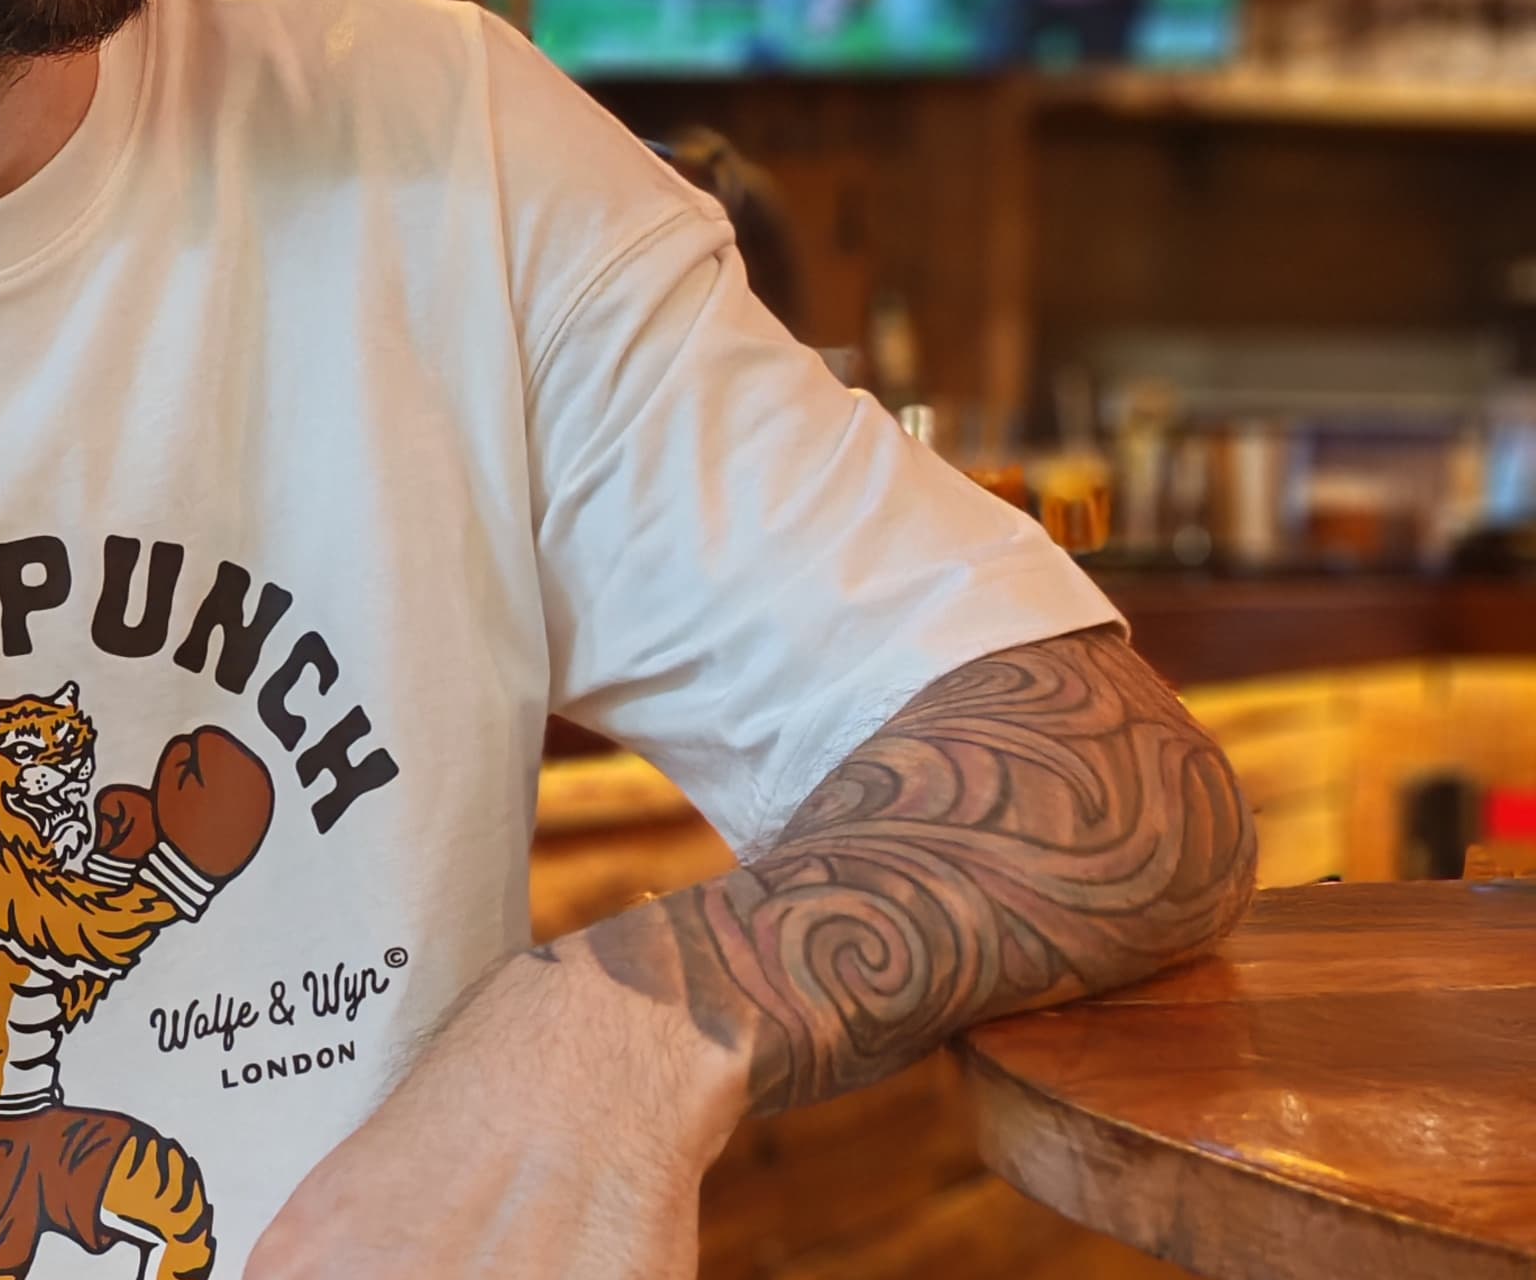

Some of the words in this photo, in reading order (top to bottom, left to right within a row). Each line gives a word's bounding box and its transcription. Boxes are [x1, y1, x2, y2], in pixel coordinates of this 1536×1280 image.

[149, 993, 260, 1052] Wolfe
[268, 980, 295, 1026] &
[221, 1040, 355, 1089] LONDON
